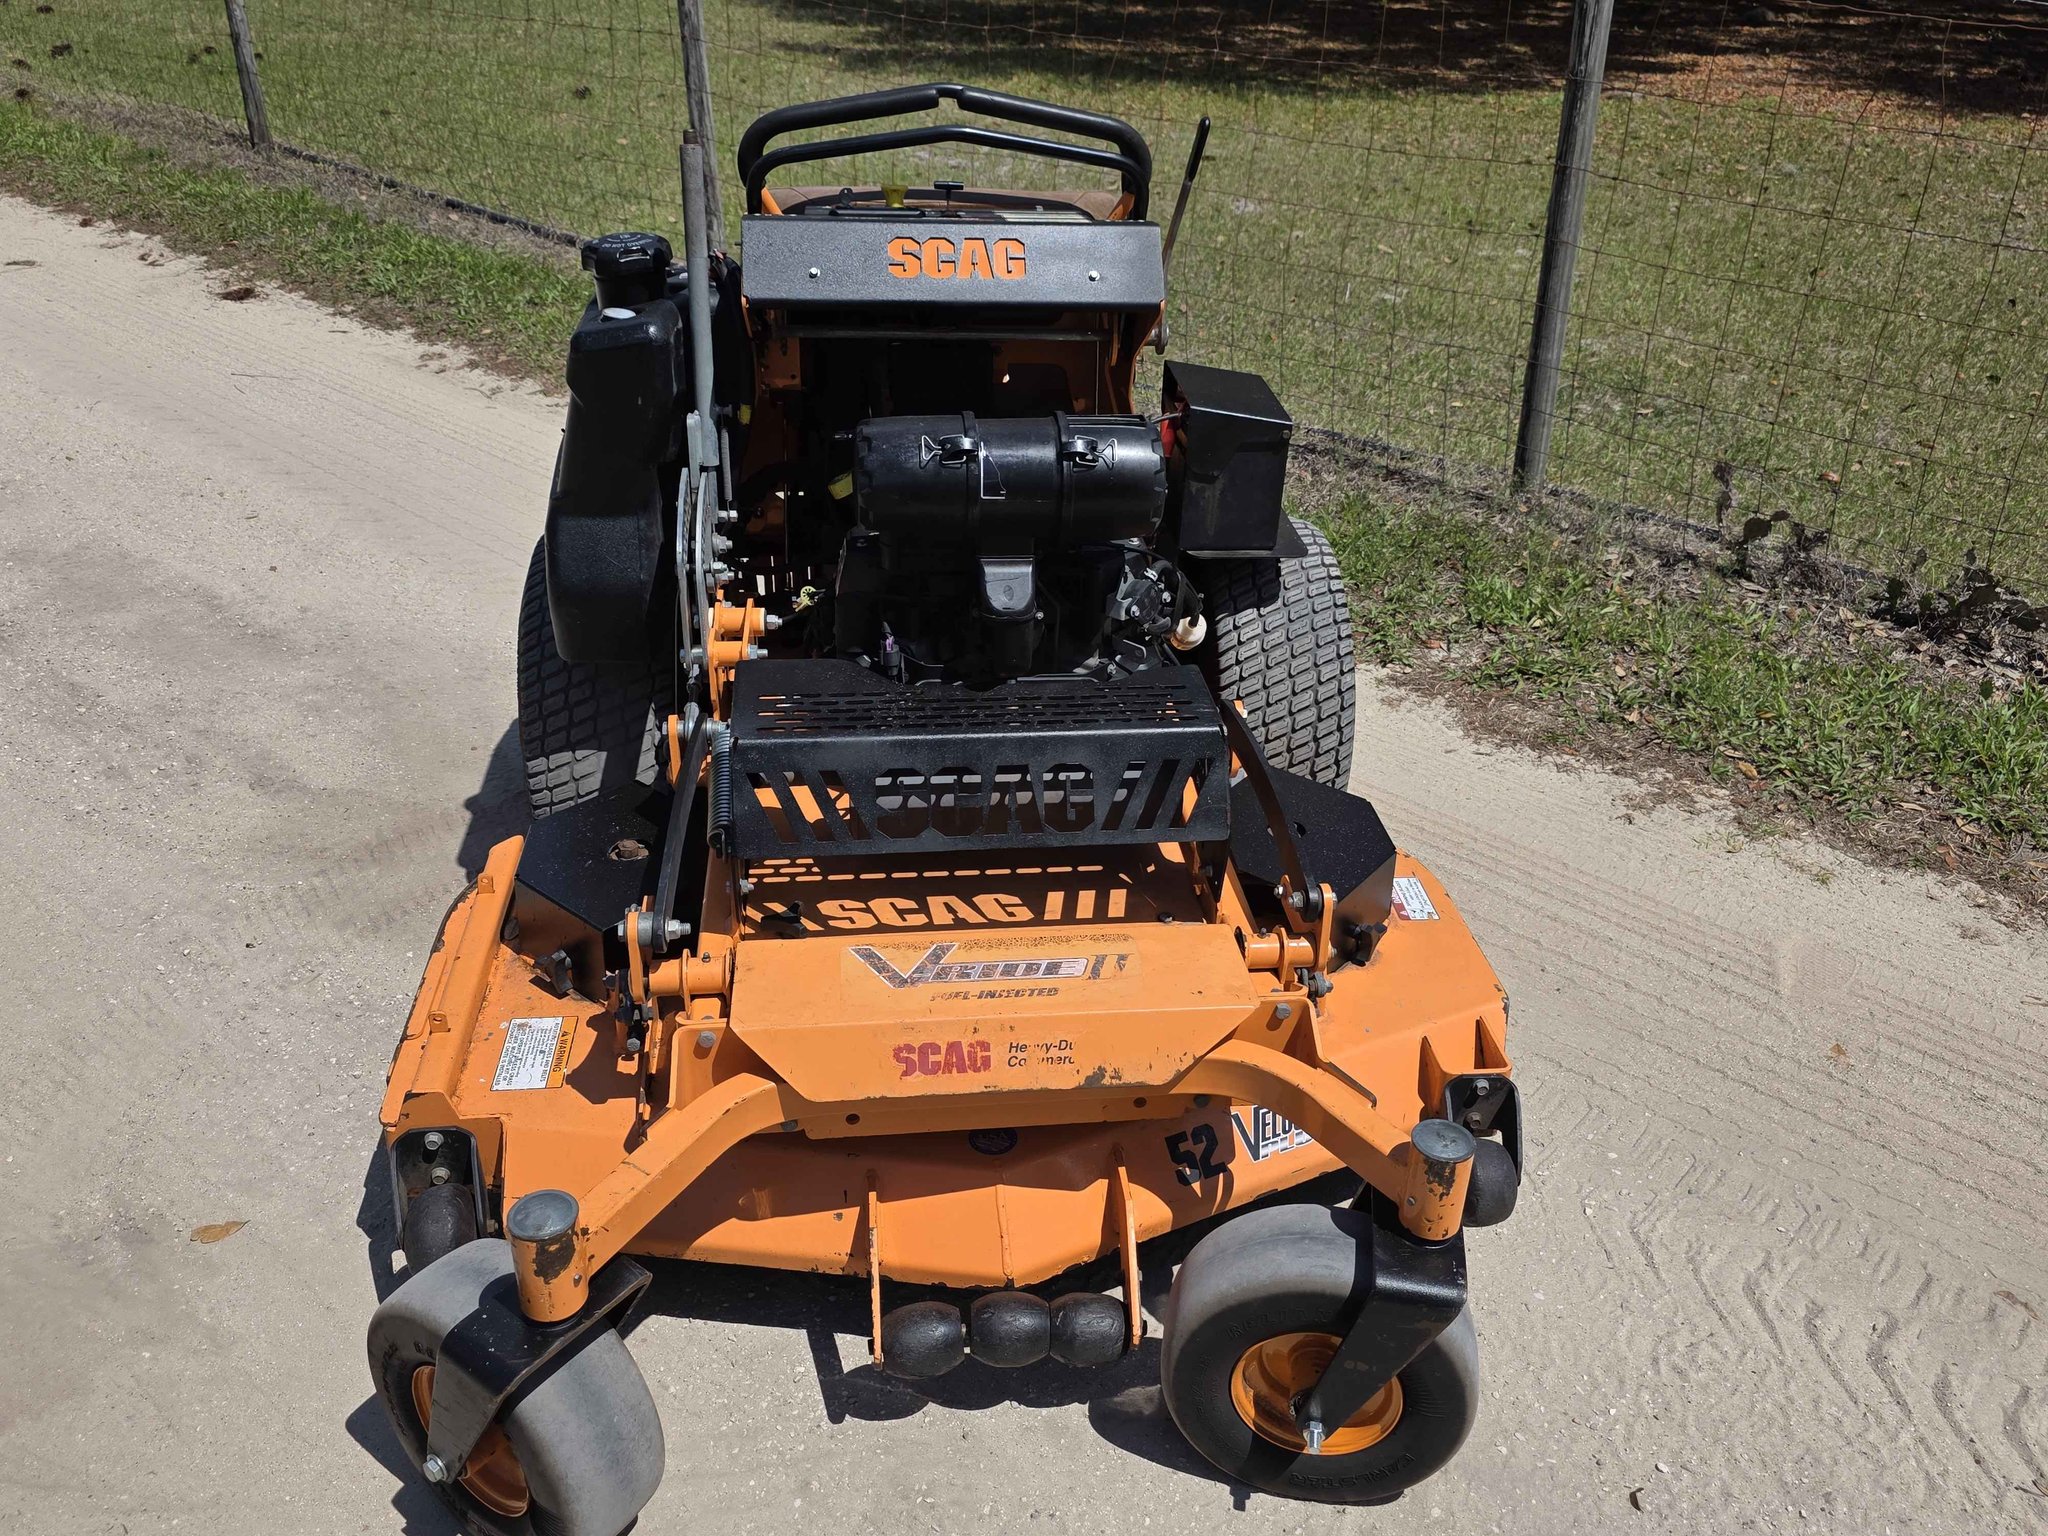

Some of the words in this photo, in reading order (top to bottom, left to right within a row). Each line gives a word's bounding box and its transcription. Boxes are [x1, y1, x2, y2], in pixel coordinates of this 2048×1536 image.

[887, 236, 1026, 280] SCAG
[875, 763, 1095, 840] SCAG
[552, 1038, 568, 1072] WARNING
[893, 1039, 992, 1078] SCAG
[1165, 1124, 1228, 1186] 52
